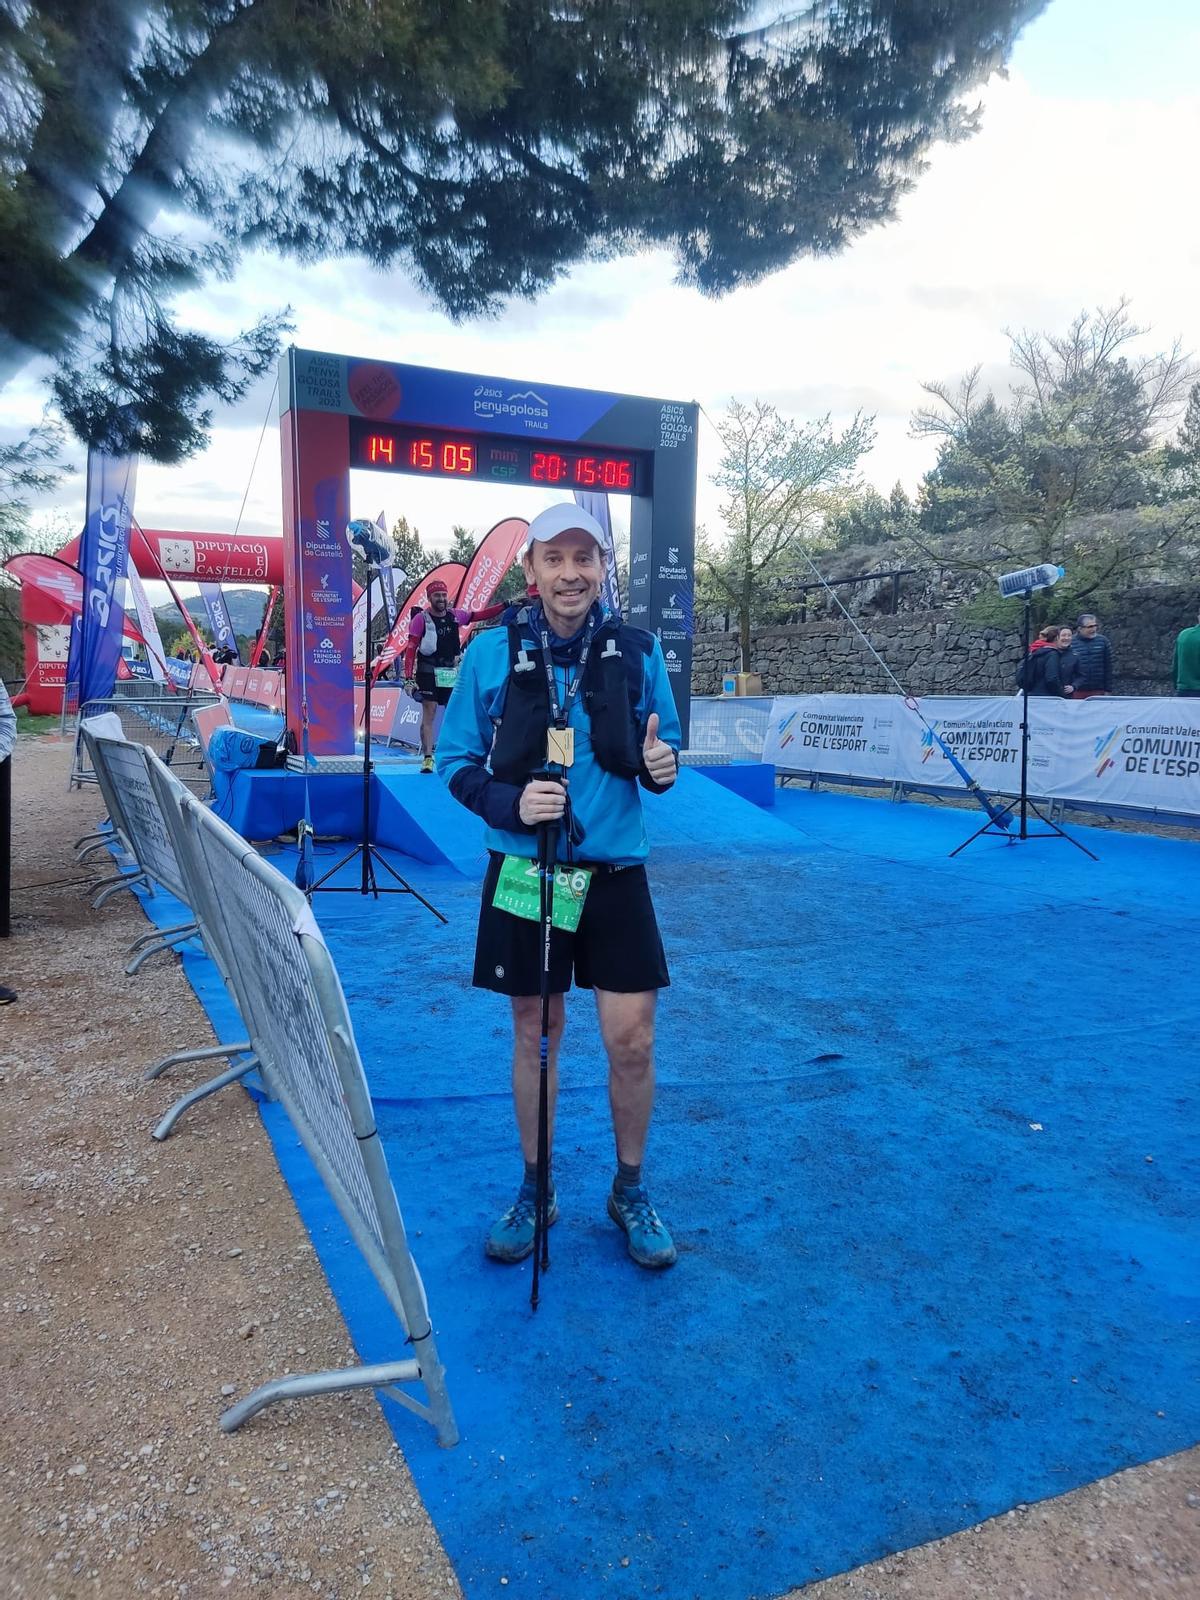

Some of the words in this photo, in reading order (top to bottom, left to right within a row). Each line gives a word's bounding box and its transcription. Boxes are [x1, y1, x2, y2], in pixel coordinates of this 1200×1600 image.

[474, 400, 549, 417] penyagolosa
[660, 404, 685, 415] ASICS
[660, 413, 686, 424] PENYA
[524, 420, 549, 430] TRAILS
[660, 423, 693, 434] GOLOSA
[660, 431, 687, 441] TRAILS
[660, 439, 678, 448] 2023
[370, 437, 393, 464] 14
[443, 444, 472, 472] 05
[533, 453, 630, 487] 20:15:06
[195, 541, 264, 554] DIPUTACIÓ
[305, 541, 342, 551] Diputació
[196, 565, 265, 577] CASTELLÓ
[659, 566, 687, 574] Diputació
[39, 663, 67, 671] DIPUTA
[40, 676, 66, 684] CASTE
[802, 711, 837, 721] Comunitat
[837, 715, 865, 723] Valenciana
[800, 721, 863, 738] COMUNITAT
[1125, 725, 1175, 736] Comunitat
[803, 735, 821, 748] DE
[822, 737, 868, 752] L'ESPORT
[939, 731, 1012, 747] COMUNITAT
[961, 748, 1019, 763] L'ESPORT
[1125, 756, 1149, 774] DE
[1152, 758, 1200, 778] L'ESP
